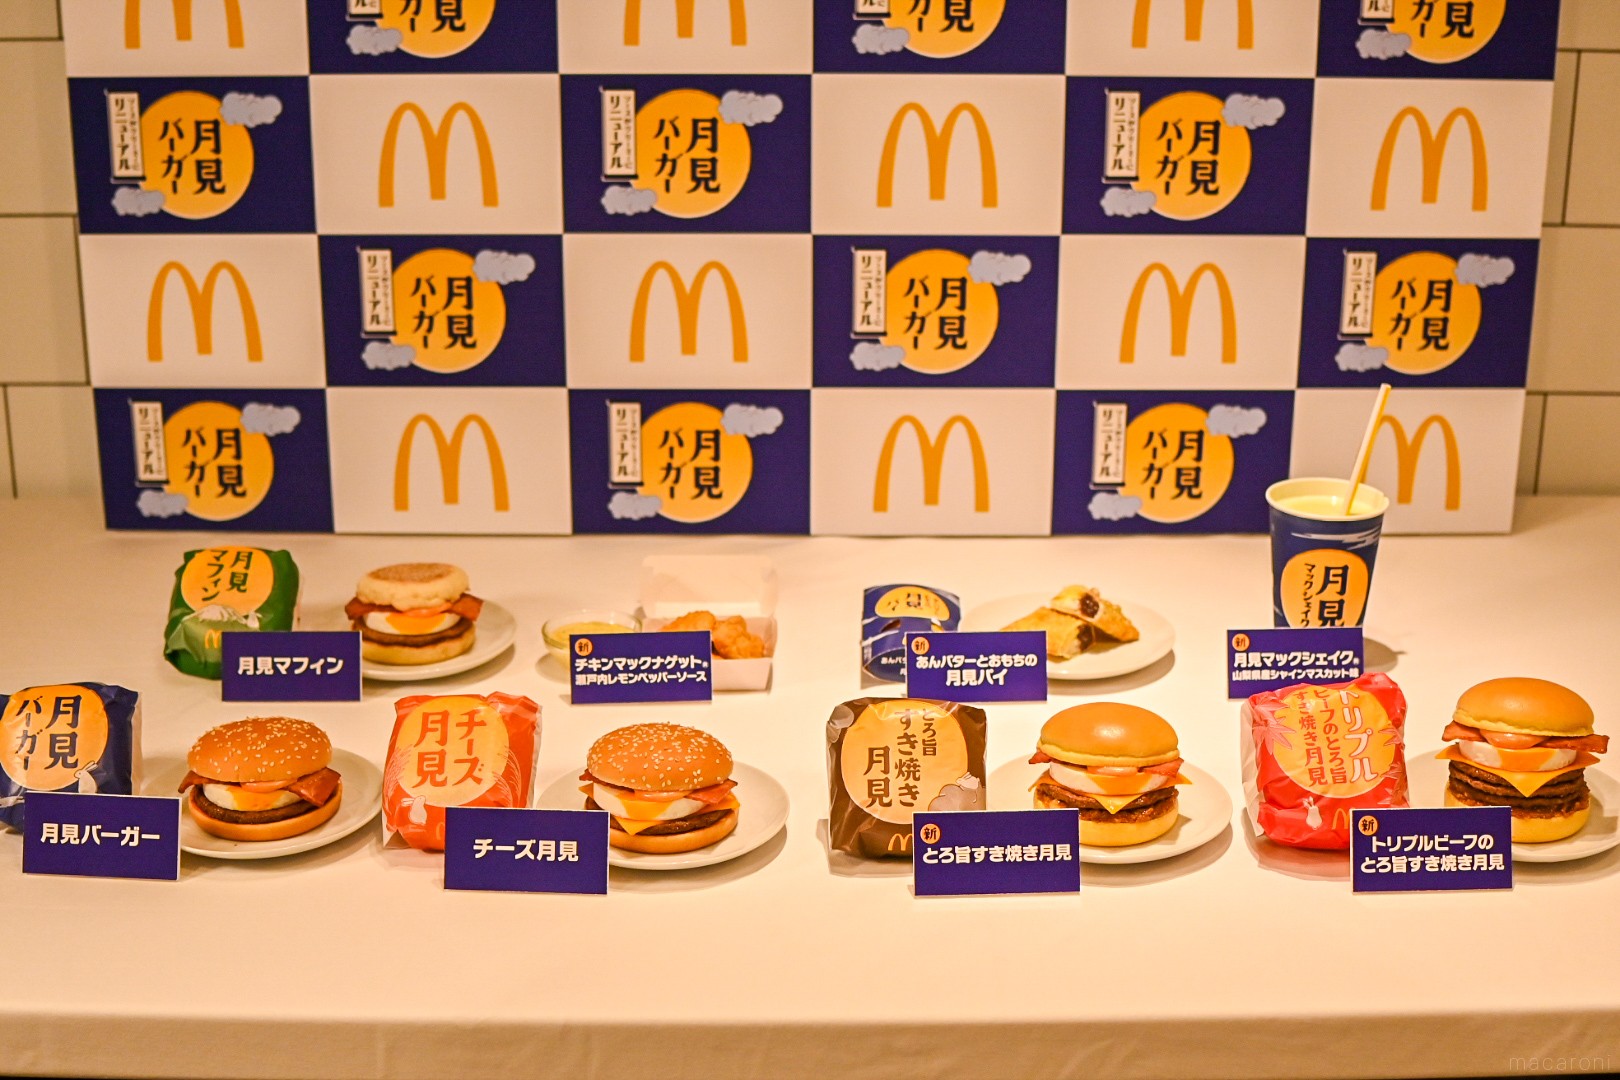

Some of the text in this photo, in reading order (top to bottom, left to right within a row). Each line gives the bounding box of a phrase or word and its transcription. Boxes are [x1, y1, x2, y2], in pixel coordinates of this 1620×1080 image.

[113, 98, 131, 171] リニューアル
[158, 118, 187, 195] バーガー
[190, 118, 226, 195] 月見
[610, 95, 623, 169] リニューアル
[653, 117, 682, 193] バーガー
[686, 117, 721, 193] 月見
[1111, 97, 1125, 171] リニューアル
[1156, 118, 1183, 195] バーガー
[1187, 119, 1221, 195] 月見
[367, 255, 381, 325] リニューアル
[411, 274, 438, 349] バーガー
[442, 275, 477, 349] 月見
[860, 255, 873, 326] リニューアル
[903, 276, 931, 349] バーガー
[935, 276, 968, 350] 月見
[1347, 256, 1363, 328] リニューアル
[1390, 279, 1417, 350] バーガー
[1420, 278, 1453, 351] 月見
[138, 407, 154, 475] リニューアル
[182, 427, 208, 497] バーガー
[212, 427, 247, 498] 月見
[616, 407, 629, 476] リニューアル
[659, 428, 686, 499] バーガー
[690, 429, 723, 499] 月見
[1100, 409, 1113, 477] リニューアル
[1143, 430, 1168, 499] バーガー
[1172, 429, 1205, 500] 月見
[201, 550, 228, 601] マフィン
[226, 551, 253, 593] 月見
[1300, 563, 1316, 627] マックシェイク
[1316, 565, 1349, 628] 月見
[237, 656, 344, 676] 月見マフィン
[915, 653, 1038, 669] あんバターとおもちの
[945, 668, 1008, 687] 月見パイ
[15, 696, 43, 771] バーガー
[44, 694, 82, 770] 月見
[411, 709, 449, 789] 月見
[452, 709, 487, 787] チーズ
[894, 708, 921, 808] すき焼き
[921, 708, 938, 757] とろ旨
[1339, 689, 1378, 784] トリプル
[863, 745, 892, 809] 月見
[40, 822, 160, 847] 月見バーガー
[472, 838, 579, 862] チーズ月見
[922, 843, 1072, 864] とろ旨すき焼き月見
[1360, 853, 1505, 873] とろ旨すき焼き月見
[1371, 834, 1494, 853] トリプルビーフの
